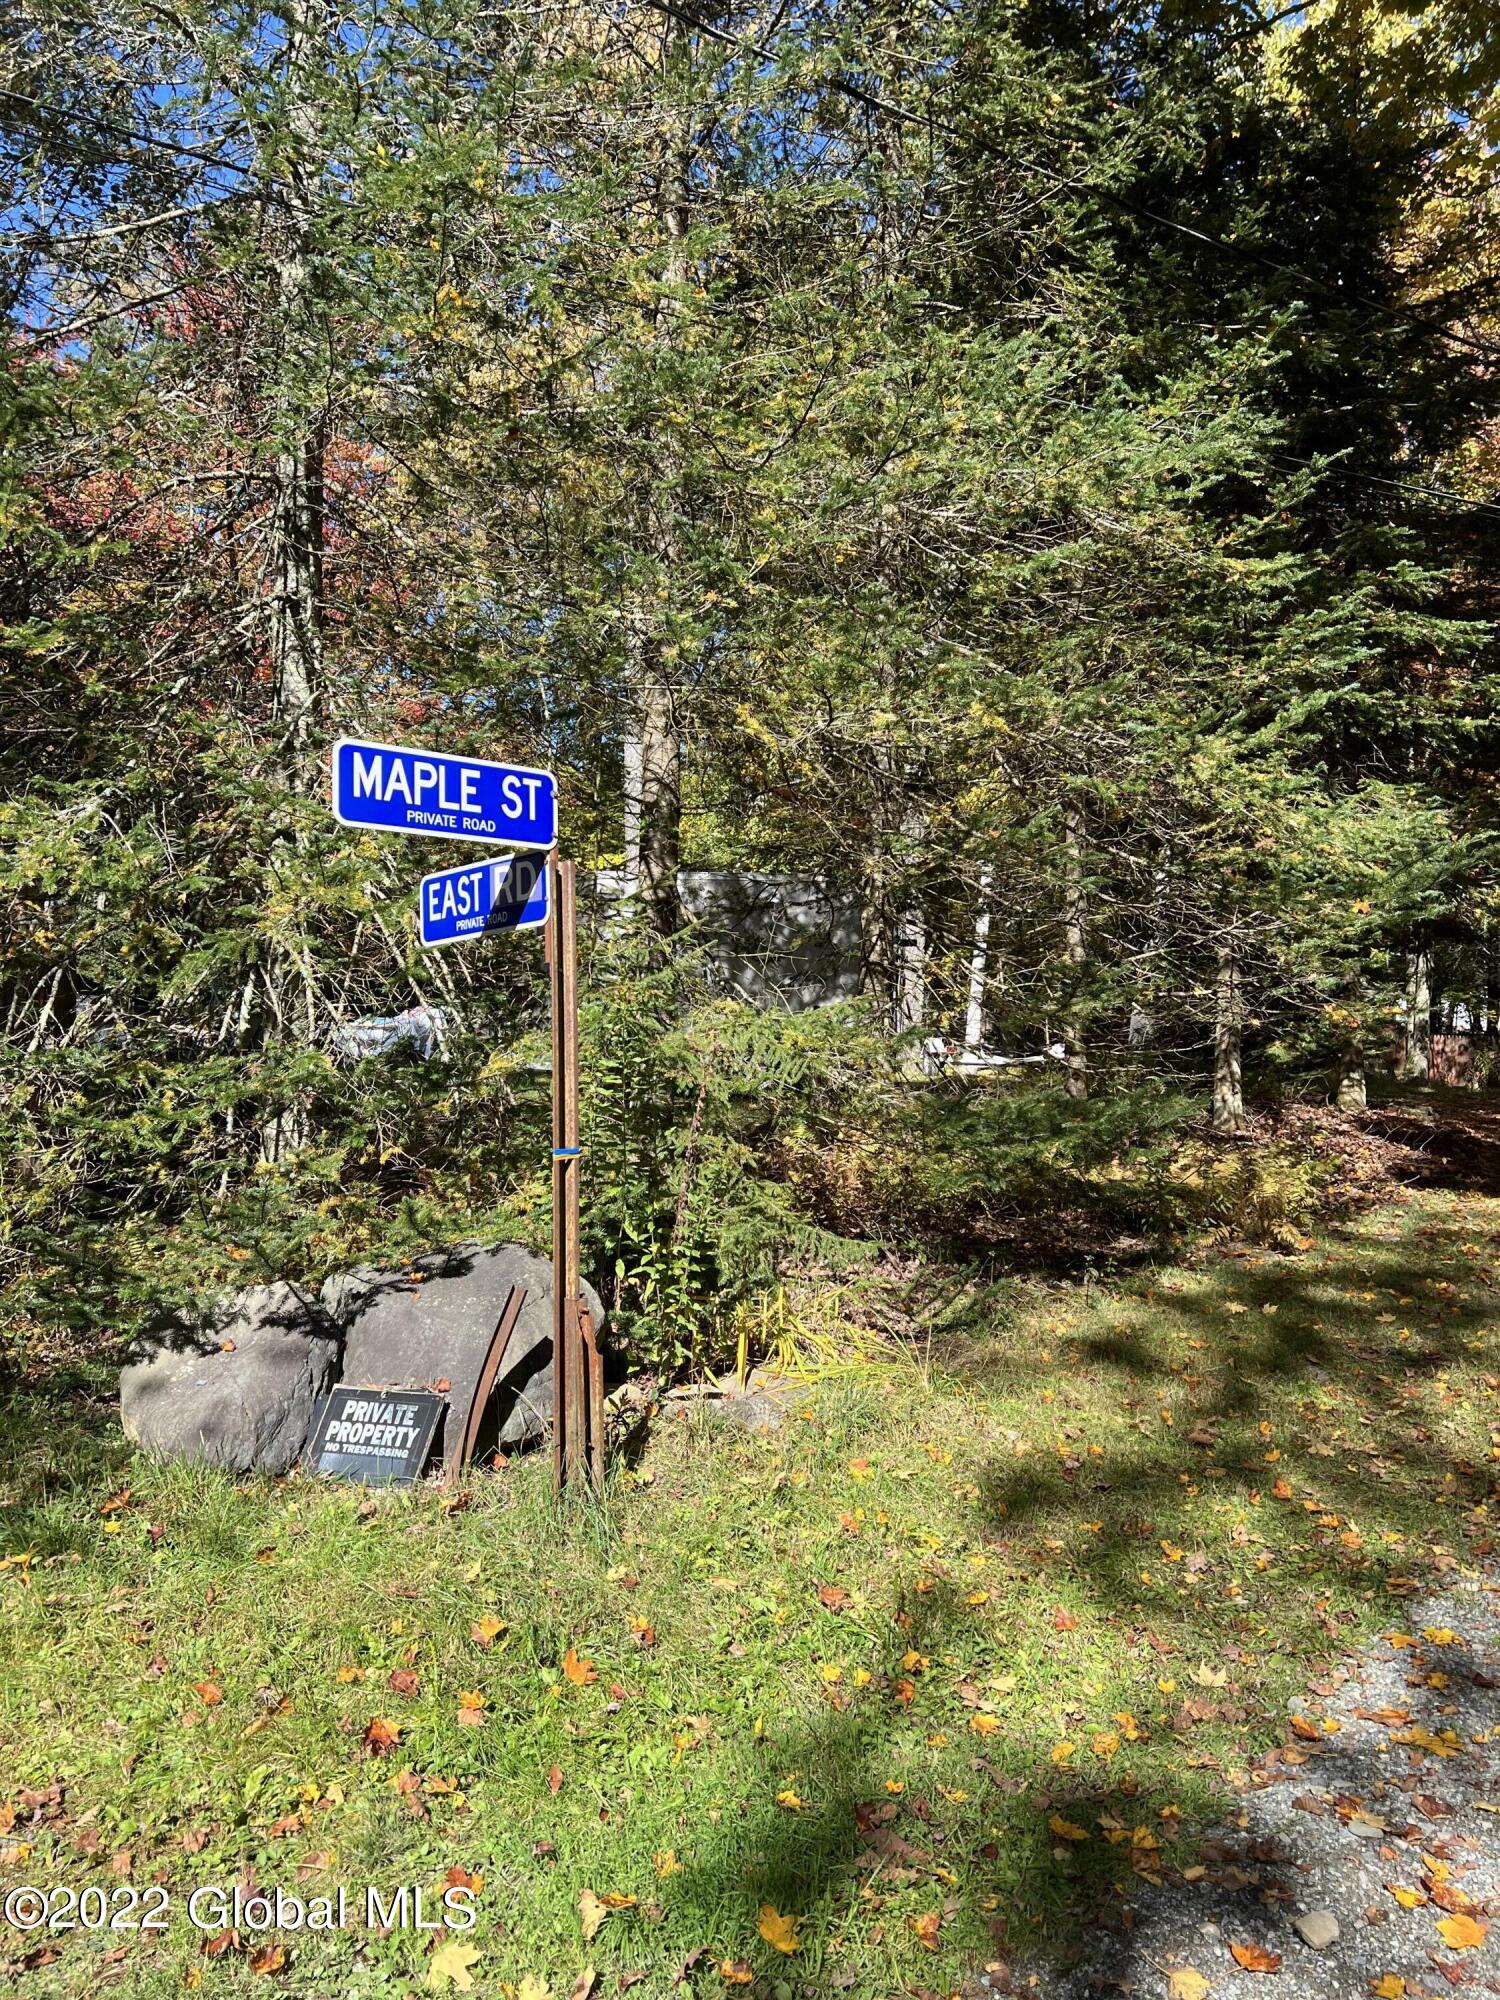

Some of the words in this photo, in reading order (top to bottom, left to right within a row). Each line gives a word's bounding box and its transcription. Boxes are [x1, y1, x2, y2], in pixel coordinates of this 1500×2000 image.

[353, 752, 482, 813] MAPLE
[501, 774, 542, 821] ST
[406, 810, 457, 828] PRIVATE
[462, 817, 496, 832] ROAD
[428, 872, 483, 922] EAST
[491, 860, 536, 906] RD
[456, 915, 485, 931] PRIVATE
[486, 911, 508, 926] ROAD
[341, 1400, 419, 1426] PRIVATE
[324, 1421, 420, 1449] PROPERTY
[324, 1443, 339, 1452] NO
[342, 1443, 409, 1459] TRESPASSING
